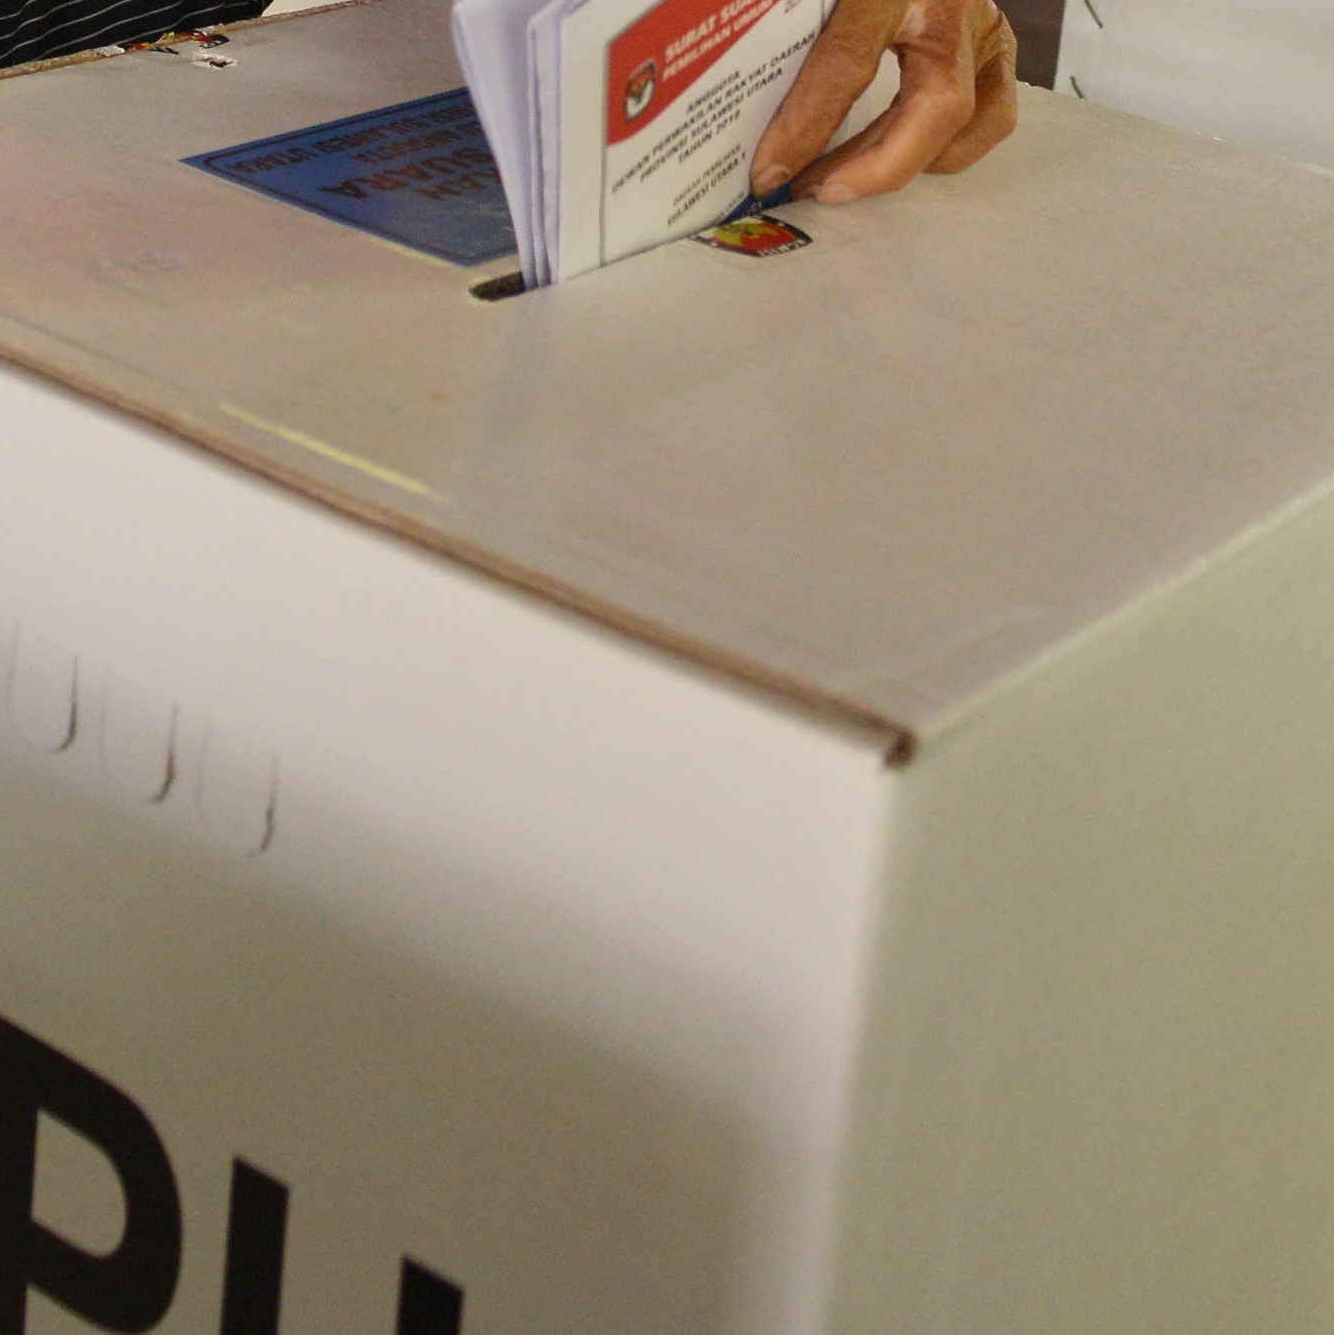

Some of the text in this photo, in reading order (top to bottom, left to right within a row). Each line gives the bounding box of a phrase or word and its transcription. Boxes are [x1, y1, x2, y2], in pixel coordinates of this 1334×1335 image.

[663, 25, 732, 81] PEMILIHAN
[665, 14, 717, 63] SURAT
[613, 31, 815, 193] DEWAN PERWAKILAN RAKYAT DAERAH
[687, 71, 740, 113] ANGGOTA
[640, 67, 783, 183] PROVINSI SULAWESI UTARA
[678, 129, 712, 163] TAHUN
[318, 147, 492, 199] SUARA
[668, 182, 709, 225] SULAWESI
[710, 161, 739, 192] UTARA
